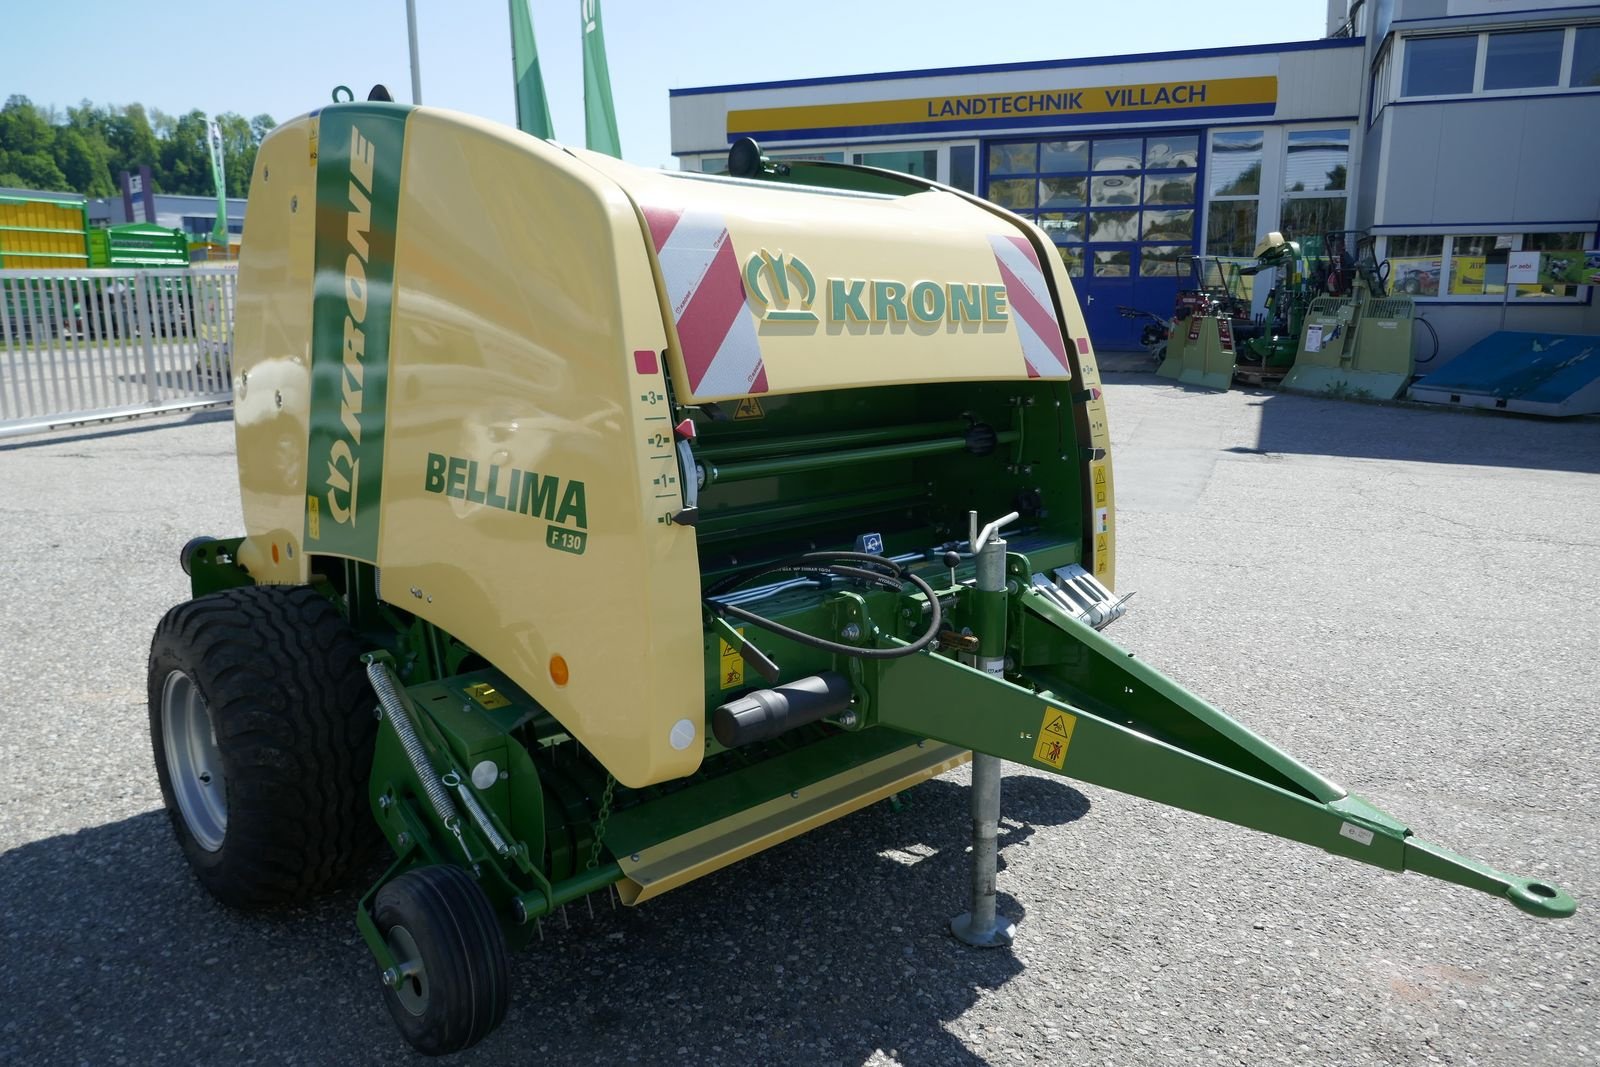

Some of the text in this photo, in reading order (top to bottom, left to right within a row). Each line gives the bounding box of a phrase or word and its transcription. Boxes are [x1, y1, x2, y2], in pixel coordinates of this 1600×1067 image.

[927, 84, 1207, 118] LANDTECHNIK VILLACH
[340, 124, 375, 446] KRONE
[826, 277, 1009, 323] KRONE
[425, 452, 588, 530] BELLIMA
[551, 531, 582, 550] F 130
